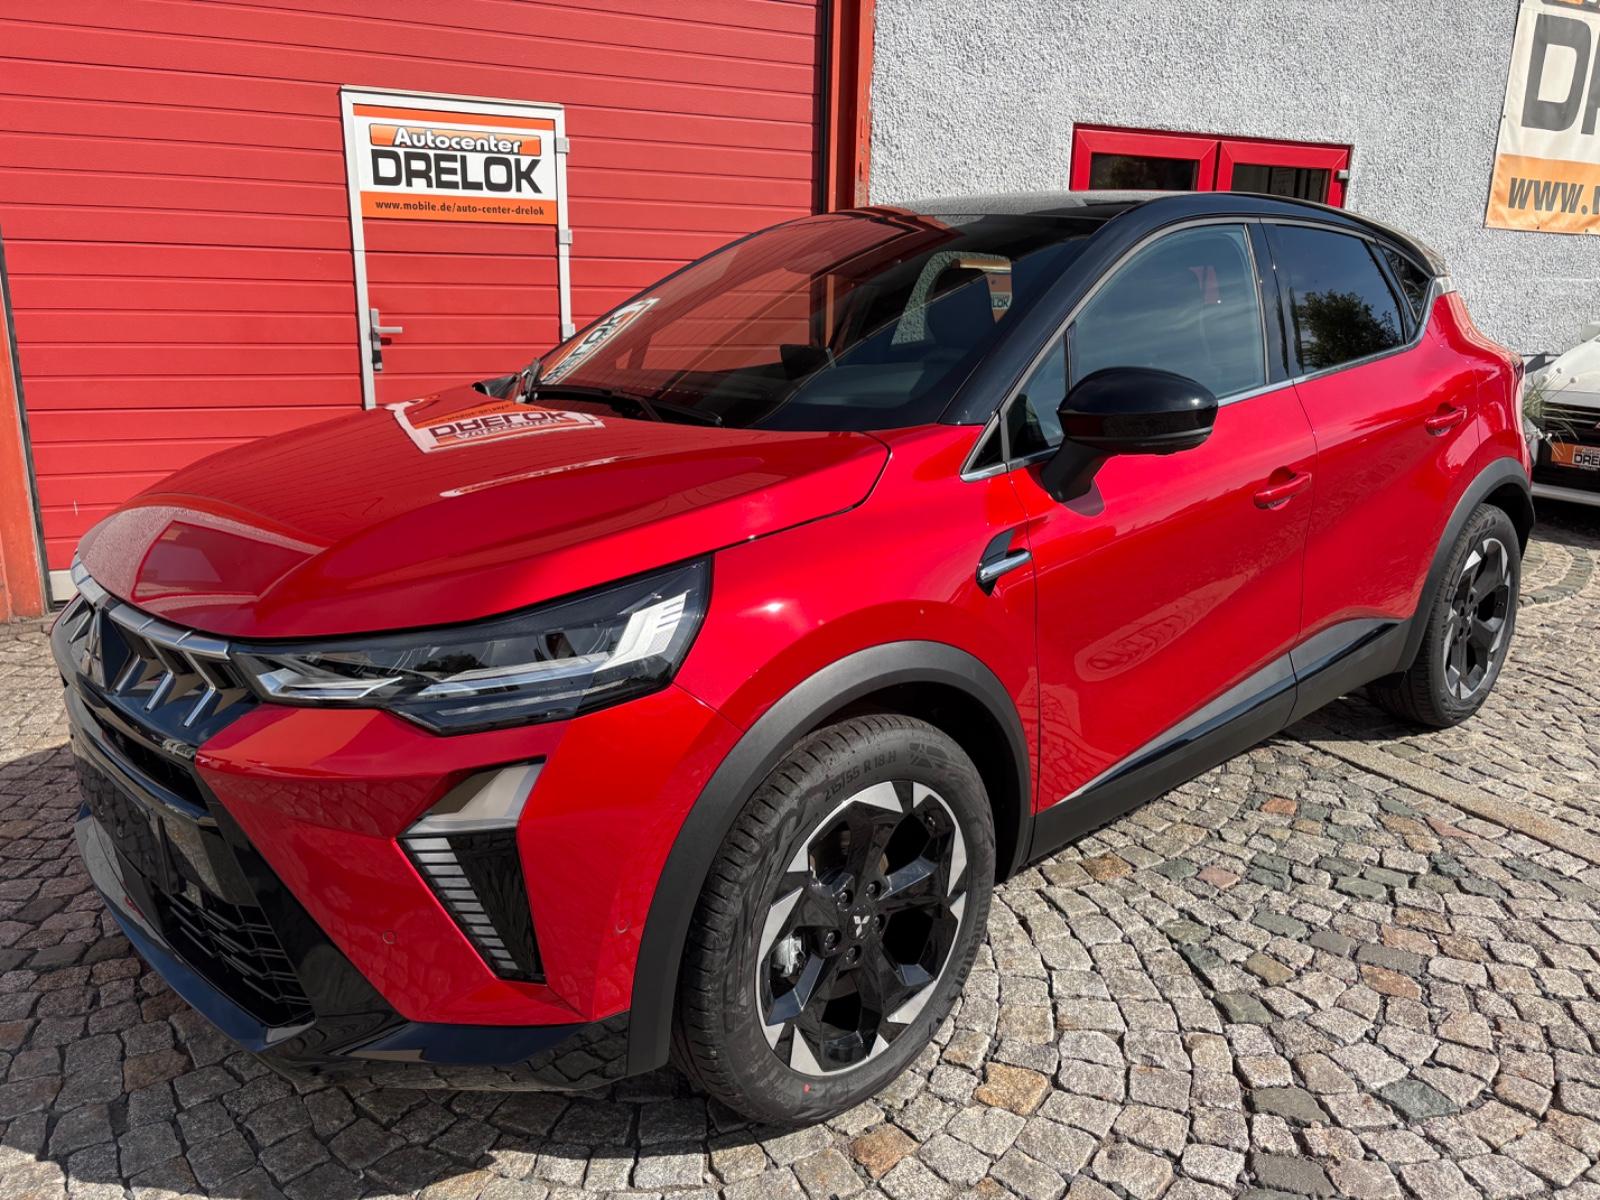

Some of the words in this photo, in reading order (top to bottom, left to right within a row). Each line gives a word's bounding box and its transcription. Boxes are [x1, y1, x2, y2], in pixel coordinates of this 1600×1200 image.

[394, 128, 521, 154] Autocenter
[371, 149, 543, 193] DRELOK
[375, 200, 545, 216] www.mobile.de/auto-center-drelok
